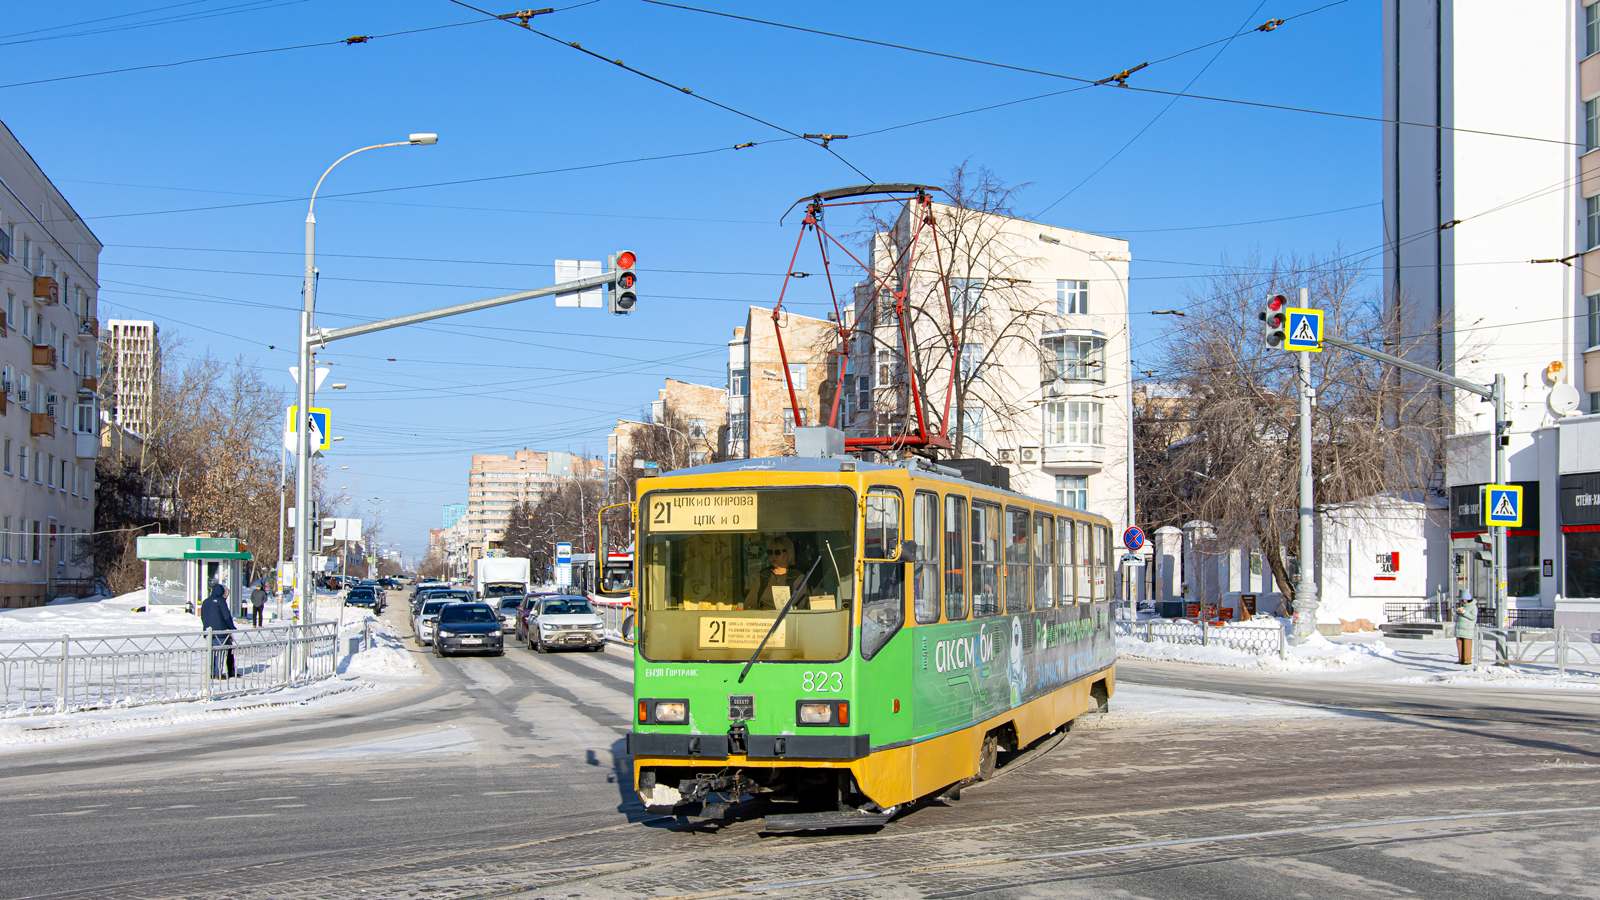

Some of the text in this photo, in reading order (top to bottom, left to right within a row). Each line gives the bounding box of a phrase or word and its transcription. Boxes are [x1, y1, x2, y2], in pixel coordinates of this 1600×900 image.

[653, 501, 671, 524] 21
[694, 515, 716, 526] ЦПК
[720, 516, 728, 525] и
[708, 621, 726, 643] 21
[802, 671, 844, 692] 823
